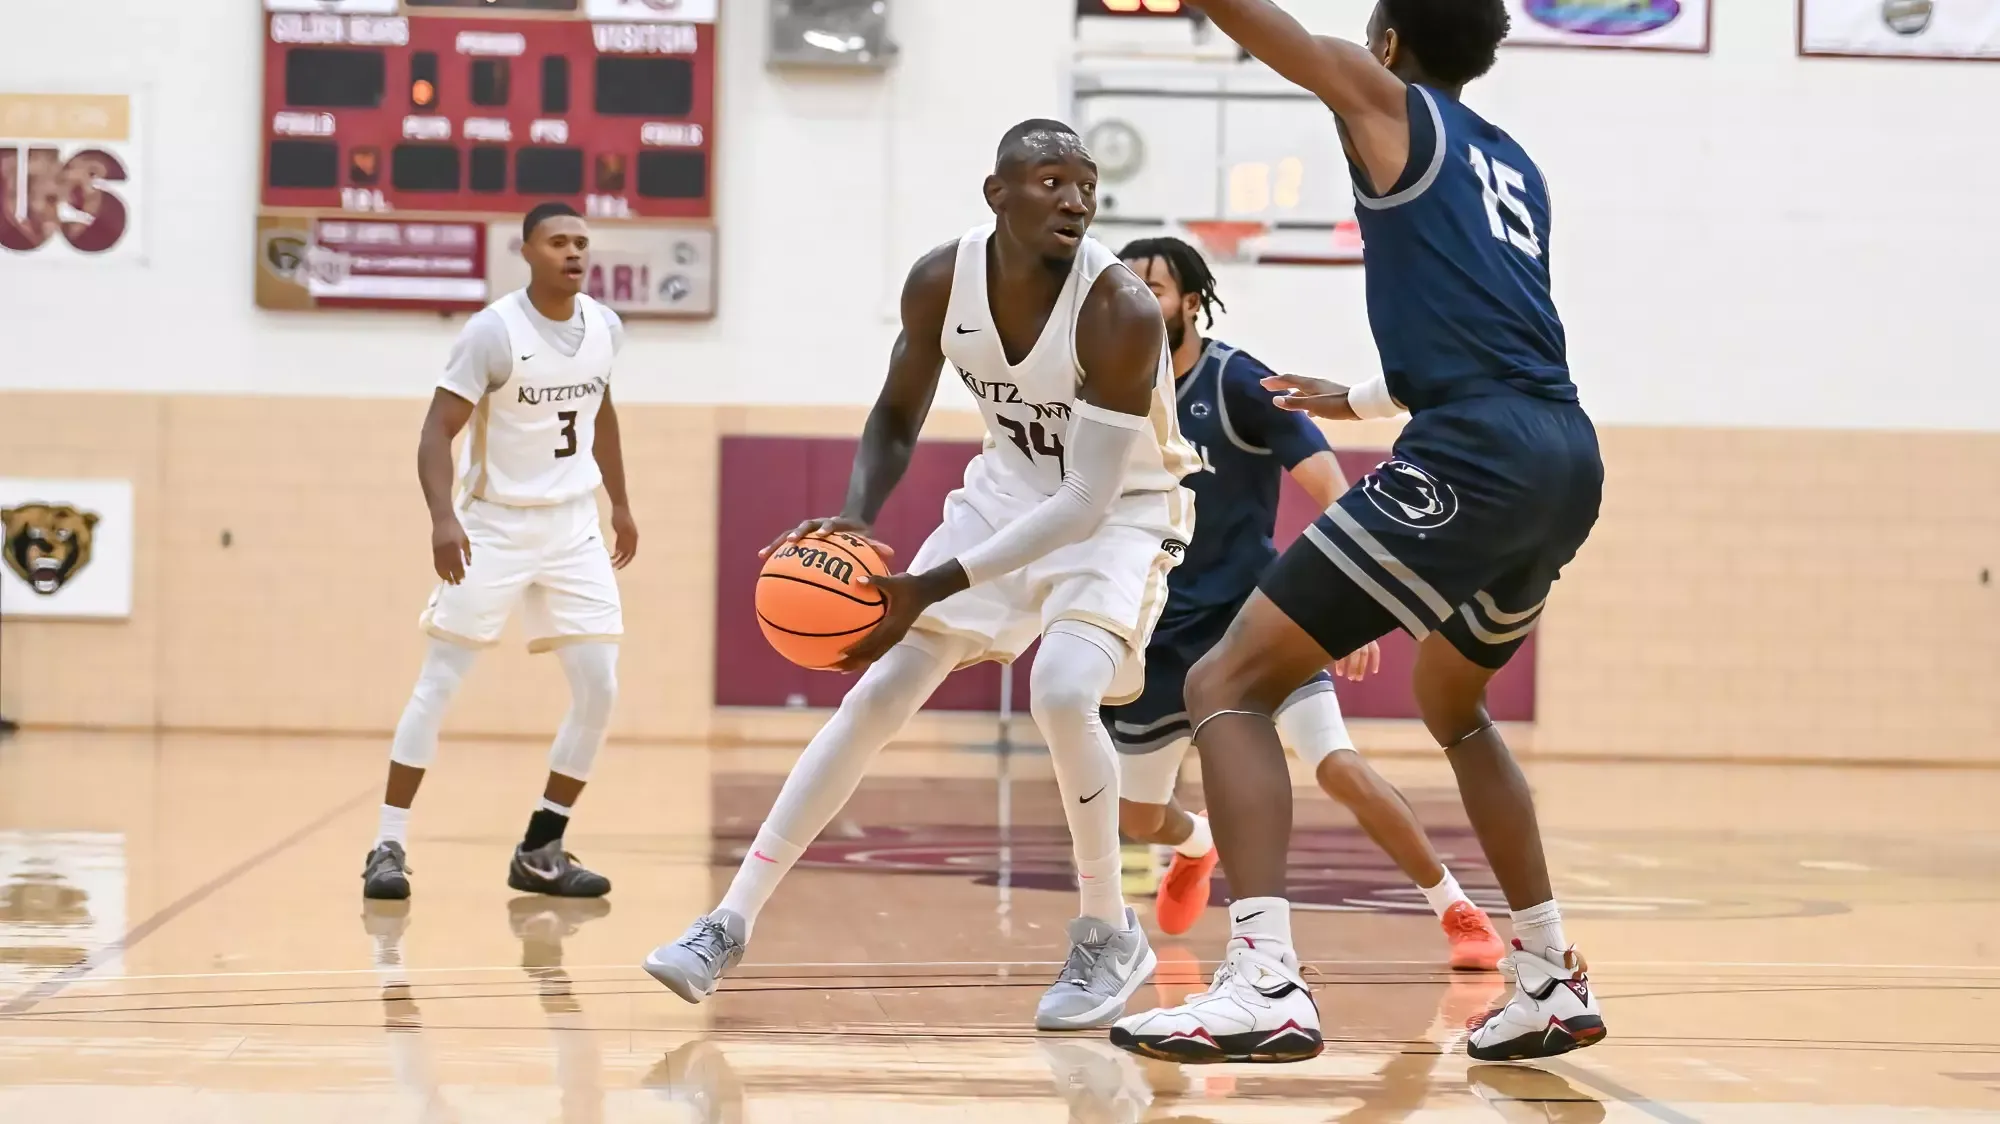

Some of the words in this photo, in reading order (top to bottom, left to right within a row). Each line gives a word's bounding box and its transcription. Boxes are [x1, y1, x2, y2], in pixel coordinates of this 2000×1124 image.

[1468, 143, 1541, 259] 15
[586, 263, 648, 305] AR!
[554, 411, 578, 459] 3
[774, 544, 853, 586] Wilson
